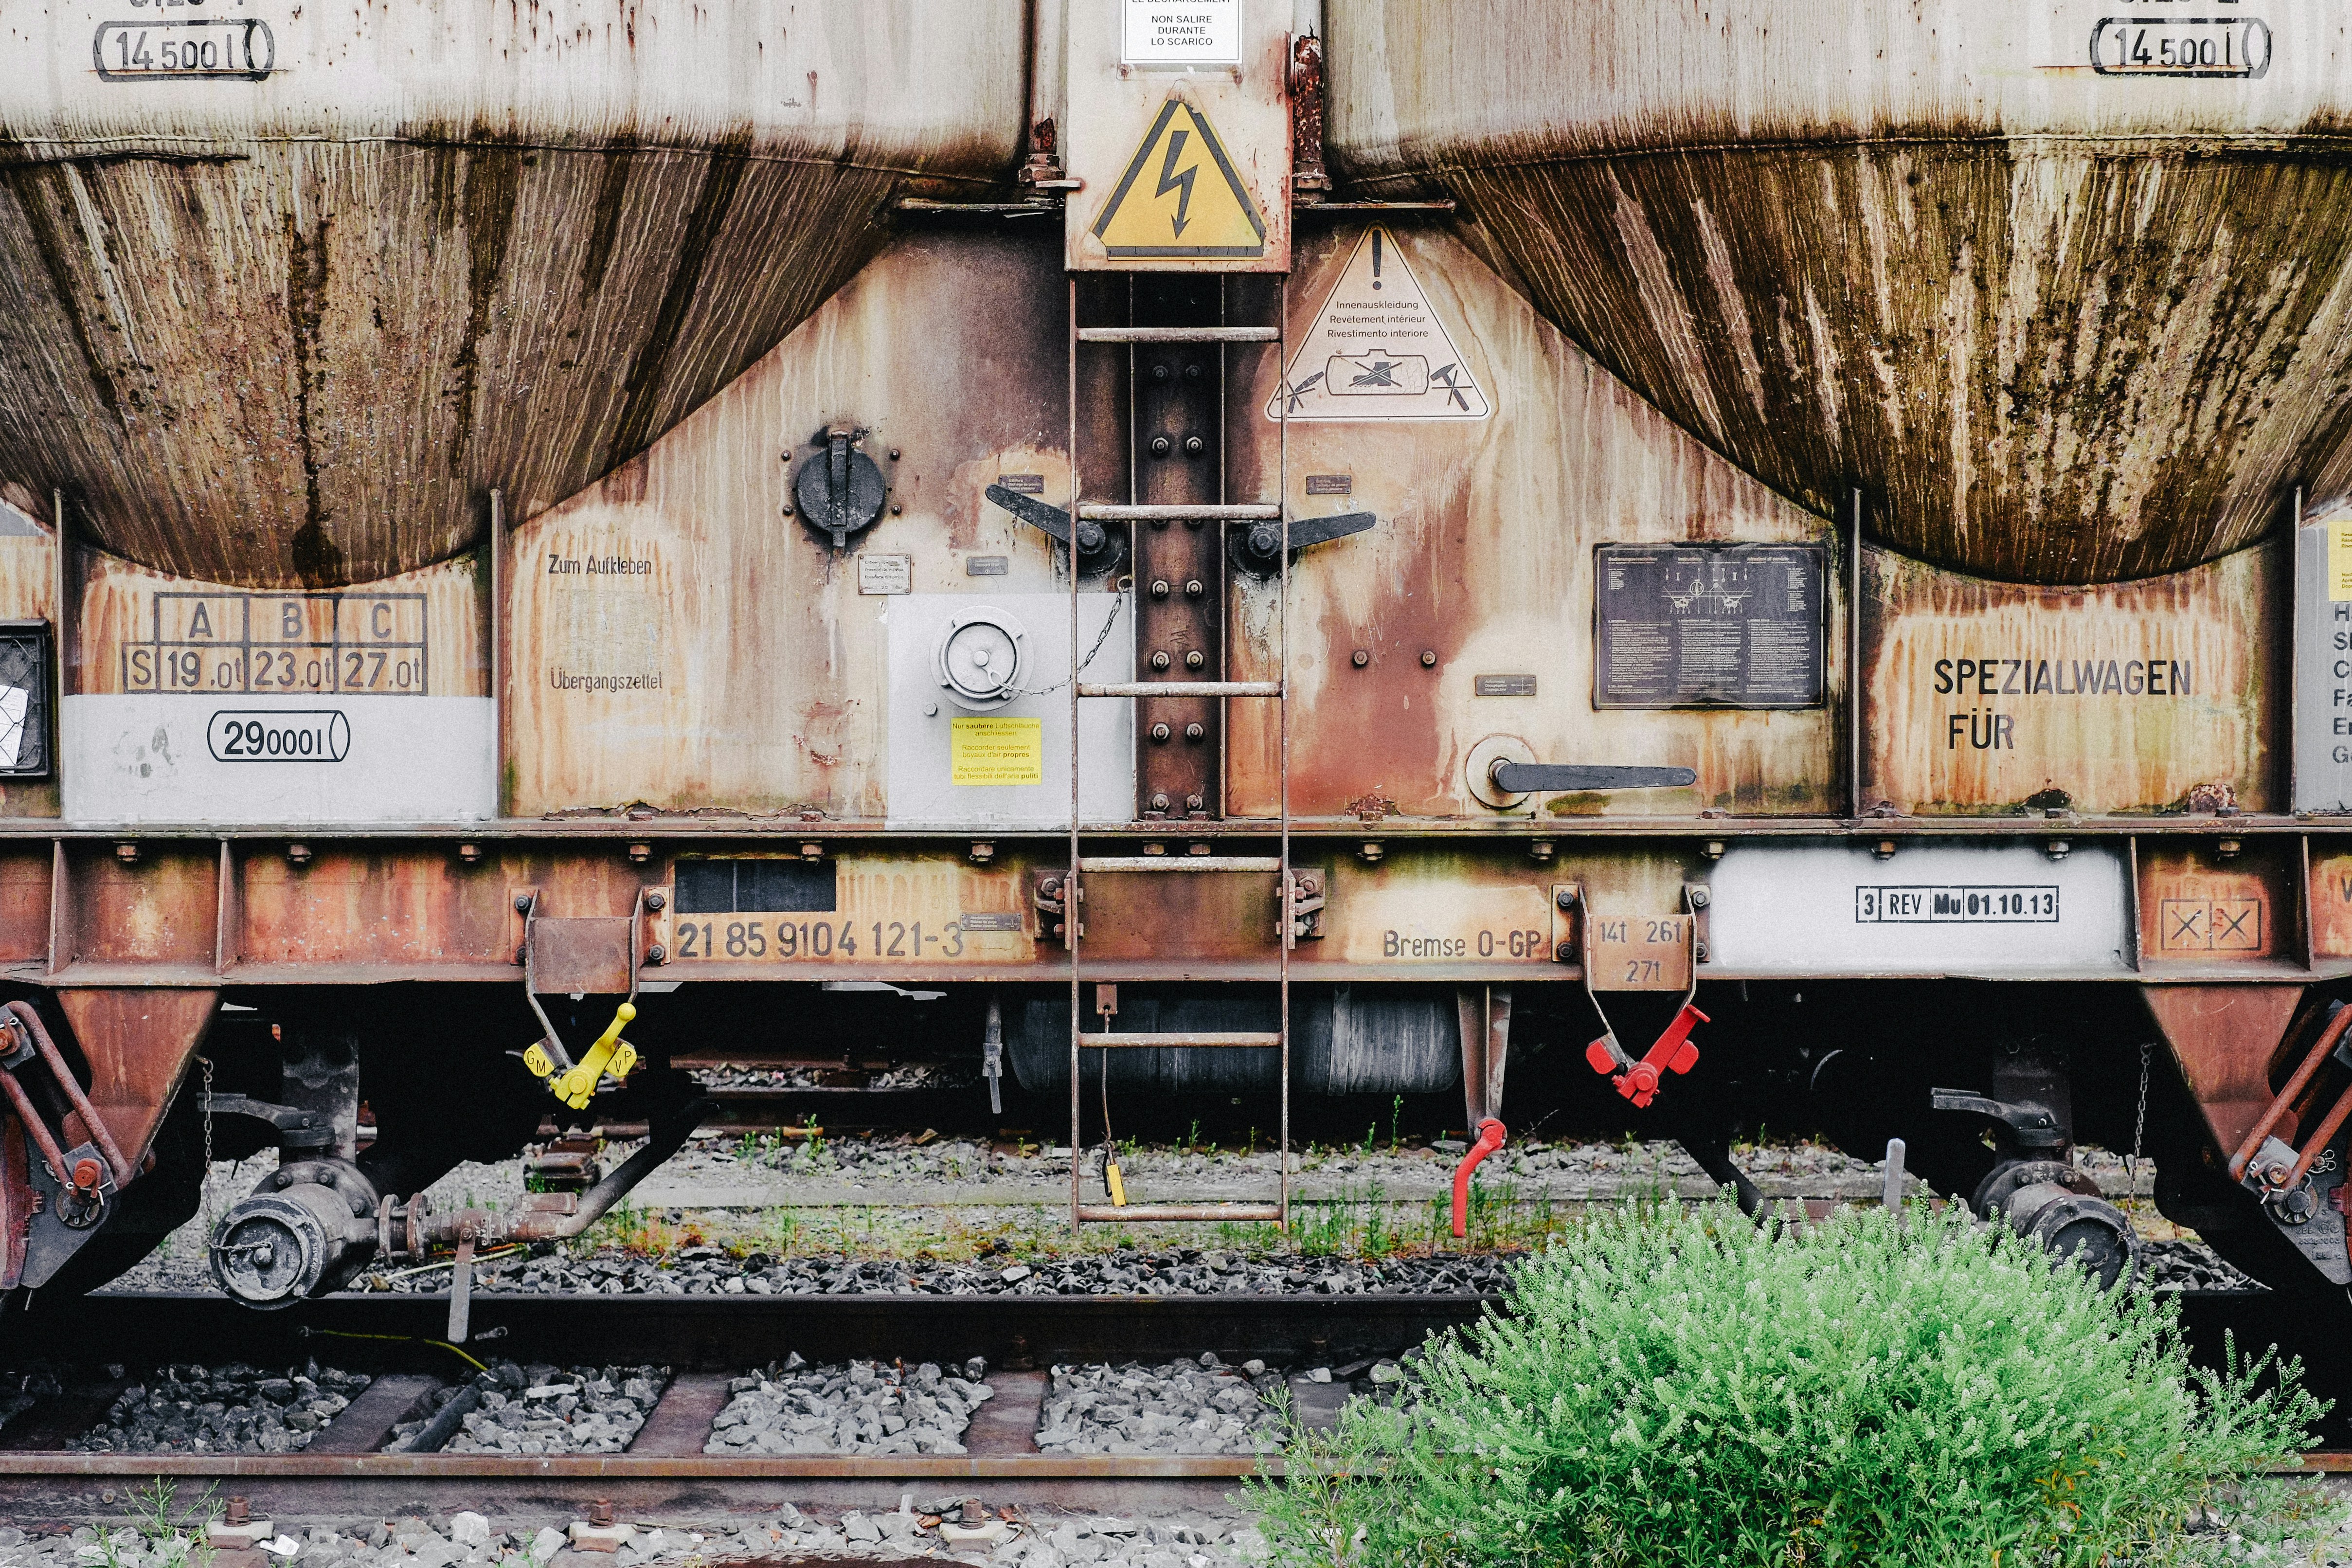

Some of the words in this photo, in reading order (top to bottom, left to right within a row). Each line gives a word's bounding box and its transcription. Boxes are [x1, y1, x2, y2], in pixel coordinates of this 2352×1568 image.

[1336, 301, 1418, 310] Innenauskleidung
[1330, 315, 1384, 324] Revêtement
[1387, 315, 1426, 323] intérieur
[1328, 329, 1387, 338] Rivestimento
[1390, 329, 1429, 338] interiore
[548, 554, 581, 575] Zum
[586, 555, 652, 575] Aufkleben
[189, 601, 213, 638] A
[283, 602, 303, 638] B
[372, 603, 391, 638] C
[132, 650, 151, 685] S
[1934, 659, 2190, 695] SPEZIALWAGEN
[551, 667, 663, 693] Übergangszettel
[1949, 707, 2014, 750] FÜR
[1864, 894, 1874, 915] 3
[1890, 894, 1922, 915] REV
[1934, 894, 1961, 914] Mu
[1968, 894, 2053, 915] 01.10.13
[678, 922, 714, 957] 21
[726, 922, 767, 957] 85
[873, 921, 964, 957] 121-3
[1600, 921, 1627, 943] 14t
[1646, 920, 1682, 943] 26t
[1383, 930, 1466, 957] Bremse
[1626, 960, 1661, 982] 27t
[527, 1050, 535, 1064] G
[537, 1060, 545, 1073] M
[615, 1060, 622, 1073] V
[625, 1050, 632, 1064] P
